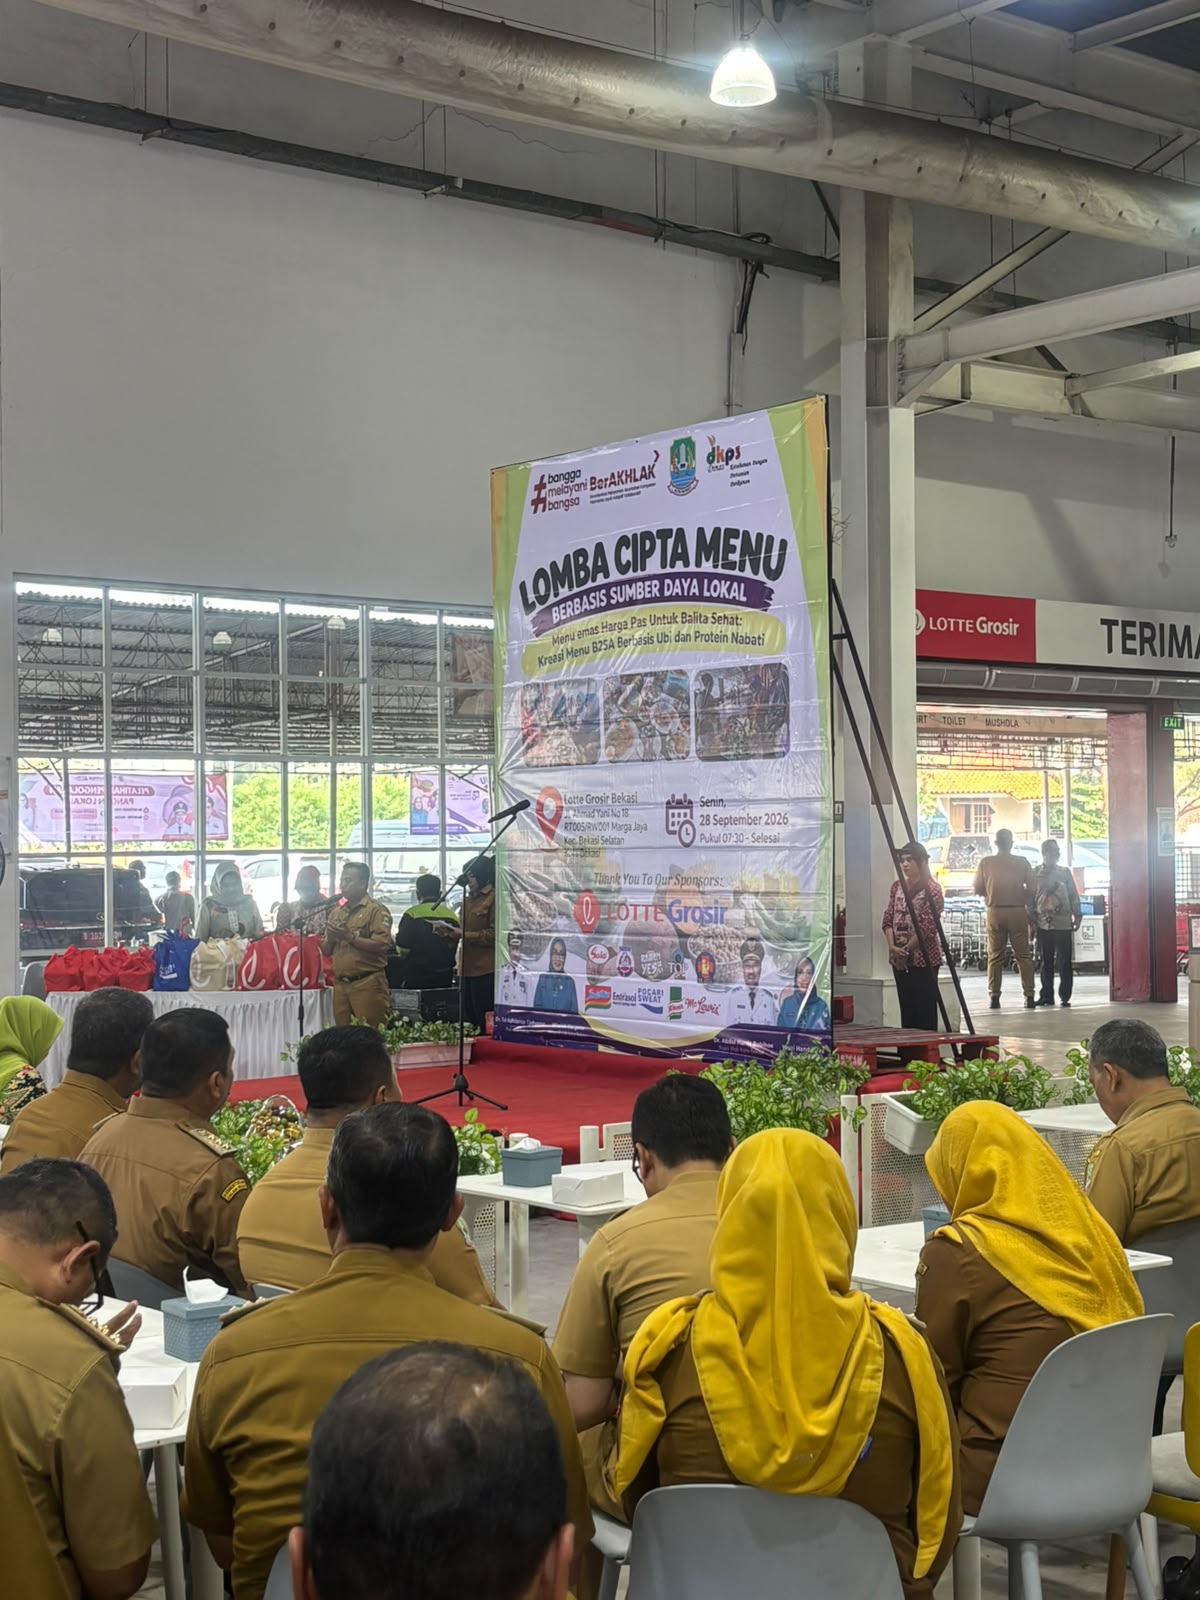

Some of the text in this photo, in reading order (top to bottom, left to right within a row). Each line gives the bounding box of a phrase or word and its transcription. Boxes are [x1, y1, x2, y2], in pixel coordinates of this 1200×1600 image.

[548, 469, 581, 485] bangga
[590, 463, 656, 491] BerAKHLAK
[548, 479, 587, 498] melayani
[548, 496, 580, 512] bangsa
[519, 526, 788, 616] LOMBA CIPTA MENU
[551, 578, 747, 624] BERBASIS SUMBER DAYA LOKAL
[552, 611, 742, 646] Menu emas Harga Pas Untuk Balita Sehat:
[929, 616, 1019, 636] LOTTE Grosir
[1100, 617, 1200, 660] TERIM
[538, 630, 765, 668] Kreasi Menu B2SA Berbasis Ubi dan Protein Nabati
[917, 714, 928, 724] RT
[943, 716, 966, 726] TOILET
[985, 717, 1019, 728] MUSHOLA
[1164, 717, 1182, 728] EXIT
[564, 791, 638, 805] Lotte Grosir Bekasi
[700, 796, 726, 808] Senin,
[621, 807, 629, 818] 18
[611, 821, 632, 833] Marga
[632, 821, 648, 833] Jaya
[700, 813, 789, 828] 28 September 2026
[579, 835, 600, 845] Bekasi
[601, 836, 624, 845] Selatan
[700, 832, 721, 844] Pukul
[722, 832, 744, 844] 07:30
[751, 832, 780, 844] Selesai
[593, 872, 724, 889] Thank You To Our Sponsors:
[606, 899, 728, 925] LOTTE Grosir
[638, 987, 664, 996] POCARI
[638, 995, 662, 1004] SWEAT
